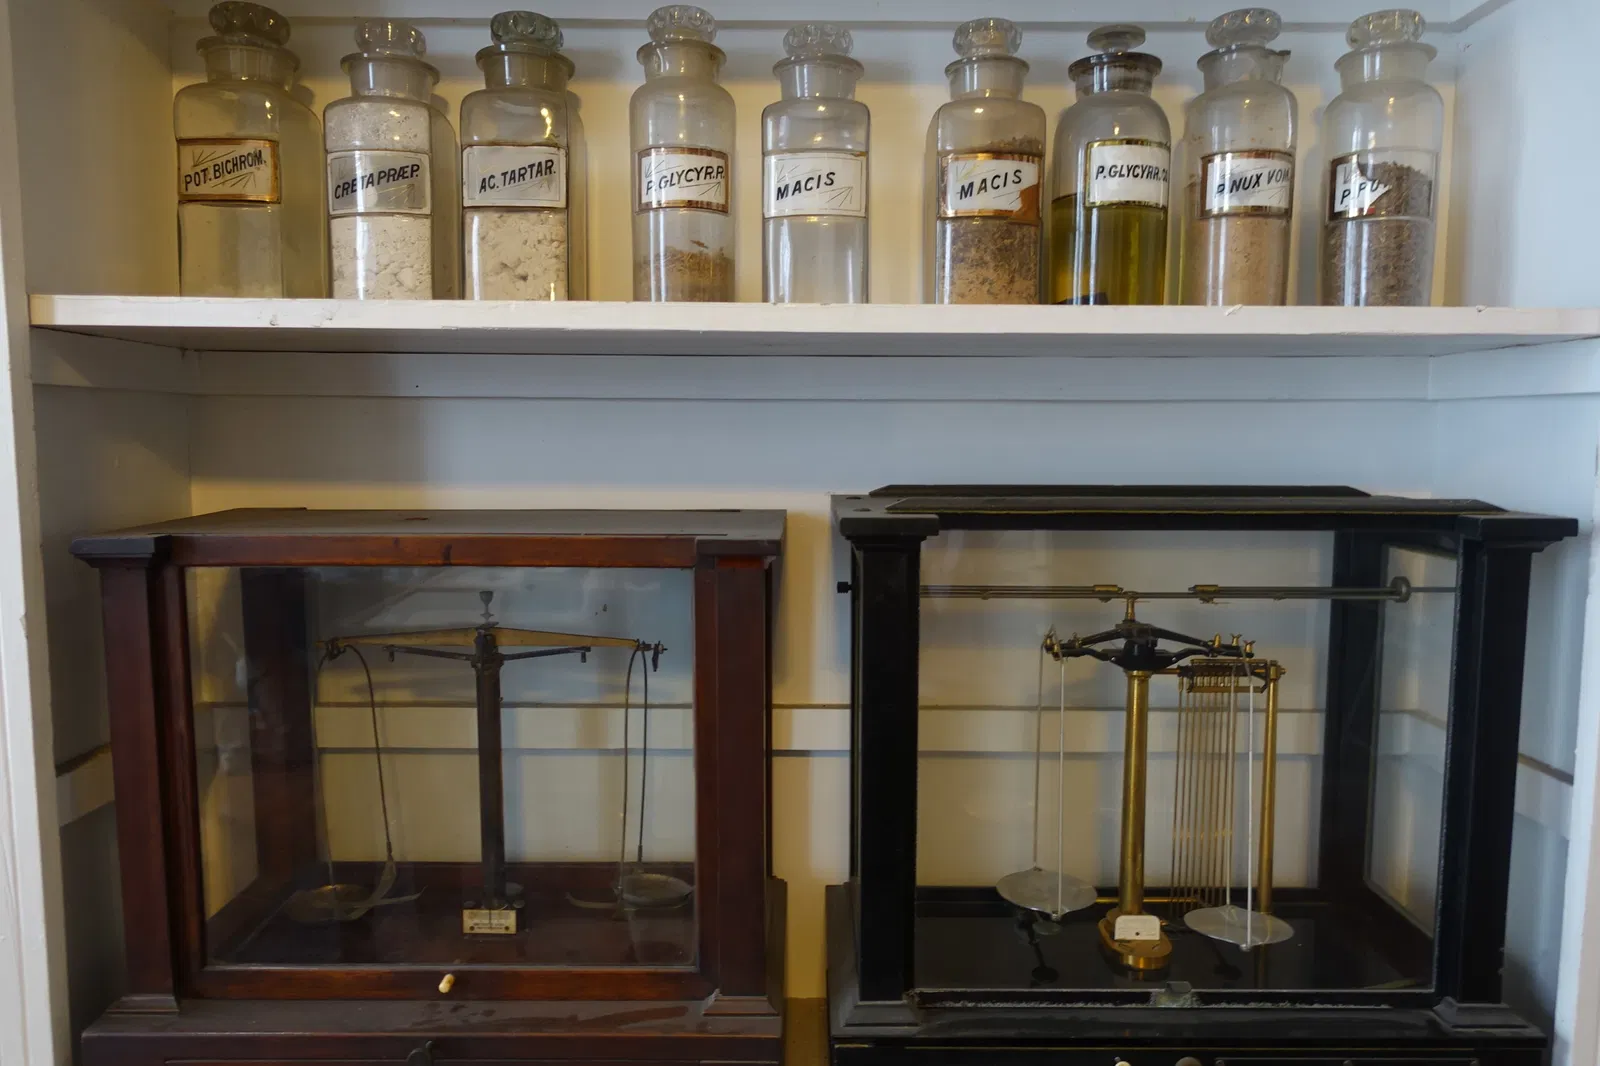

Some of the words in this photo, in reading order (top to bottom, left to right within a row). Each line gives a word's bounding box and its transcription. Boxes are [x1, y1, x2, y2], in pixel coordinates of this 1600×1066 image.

[334, 173, 374, 199] CRETA
[776, 171, 836, 201] MACIS
[959, 169, 1023, 201] MACIS
[1230, 172, 1263, 194] NUX
